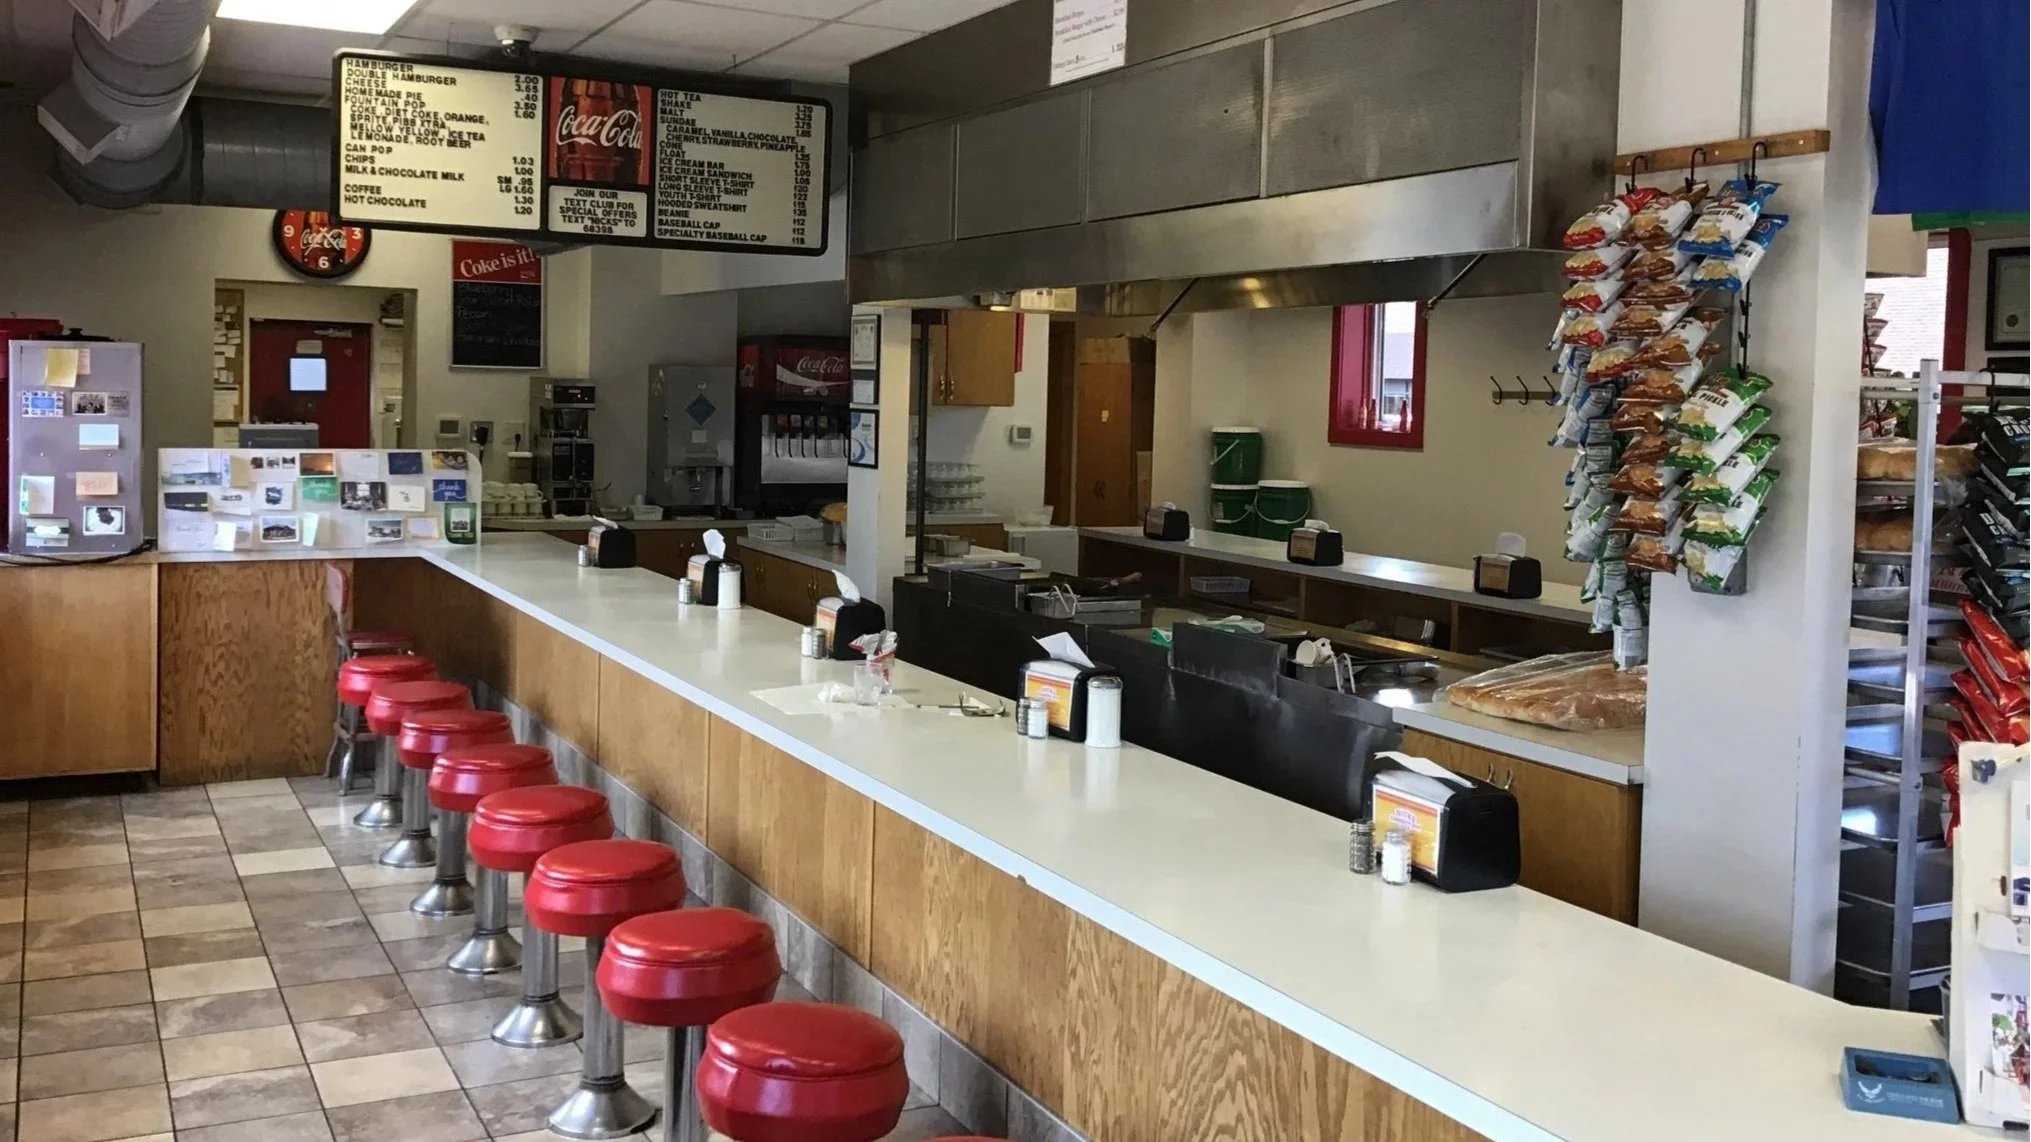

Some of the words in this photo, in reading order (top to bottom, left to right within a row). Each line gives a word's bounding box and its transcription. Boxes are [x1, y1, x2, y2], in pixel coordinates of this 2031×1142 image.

[347, 59, 414, 72] HAMBURGER
[515, 75, 539, 84] 2.00
[345, 77, 387, 88] CHEESE
[347, 68, 387, 79] DOUBLE
[392, 74, 456, 86] HAMBURGER
[515, 84, 538, 93] 3.65
[406, 92, 422, 100] PIE
[514, 101, 537, 110] 3.50
[660, 90, 679, 99] HOT
[684, 92, 701, 102] TEA
[345, 95, 398, 107] FOUNTAIN
[404, 101, 426, 109] POP
[515, 110, 535, 119] 1.60
[660, 99, 692, 109] SHAKE
[385, 108, 408, 116] DIET
[660, 107, 684, 116] MALT
[393, 117, 416, 126] PIBB
[556, 106, 642, 149] Coca-Cola
[660, 116, 696, 126] SUNDAE
[350, 123, 393, 133] MELLOW
[448, 129, 464, 140] ICE
[467, 131, 485, 141] TEA
[416, 135, 443, 146] ROOT
[447, 138, 471, 149] BEER
[659, 140, 683, 150] CONE
[760, 141, 805, 153] PINEAPPLE
[345, 143, 366, 153] CAN
[371, 145, 392, 154] POP
[512, 157, 534, 166] 1.03
[660, 149, 686, 158] FLOAT
[345, 154, 375, 164] CHIPS
[515, 167, 533, 176] 1.00
[660, 157, 673, 166] ICE
[674, 159, 705, 168] CREAM
[707, 161, 724, 170] BAR
[345, 165, 368, 174] MILK
[370, 166, 376, 175] &
[378, 167, 437, 179] CHOCOLATE
[441, 172, 465, 181] MILK
[497, 176, 512, 185] SM
[518, 178, 533, 186] .95
[659, 166, 673, 174] ICE
[674, 167, 704, 176] CREAM
[707, 169, 752, 180] SANDWICH
[659, 174, 687, 183] SHORT
[689, 176, 721, 186] SLEEVE
[722, 180, 755, 188] T-SHIRT
[345, 184, 382, 194] COFFEE
[514, 196, 533, 205] 1.30
[514, 186, 533, 195] 1.60
[574, 188, 595, 197] JOIN
[599, 191, 618, 199] OUR
[659, 182, 681, 190] LONG
[683, 184, 715, 193] SLEEVE
[717, 187, 748, 196] T-SHIRT
[659, 190, 687, 199] YOUTH
[689, 193, 722, 202] T-SHIRT
[345, 195, 364, 205] HOT
[367, 196, 426, 208] CHOCOLATE
[515, 206, 532, 215] 1.20
[564, 198, 587, 206] TEXT
[590, 200, 614, 209] CLUB
[616, 202, 634, 210] FOR
[658, 199, 693, 208] HOODED
[694, 202, 747, 212] SWEATSHIRT
[559, 206, 598, 216] SPECIAL
[602, 209, 638, 219] OFFERS
[658, 209, 690, 218] BEANIE
[561, 215, 585, 224] TEXT
[588, 216, 622, 226] "NICKS"
[624, 219, 636, 227] TO
[658, 219, 701, 228] BASEBALL
[703, 221, 721, 229] CAP
[284, 225, 294, 237] 9
[352, 228, 362, 239] 3
[658, 228, 704, 238] SPECIALTY
[706, 231, 748, 241] BASEBALL
[319, 256, 329, 268] 6
[460, 259, 500, 278] Coke
[500, 252, 516, 268] is
[797, 356, 844, 373] Coca-Cola
[1699, 392, 1728, 408] PICKLE
